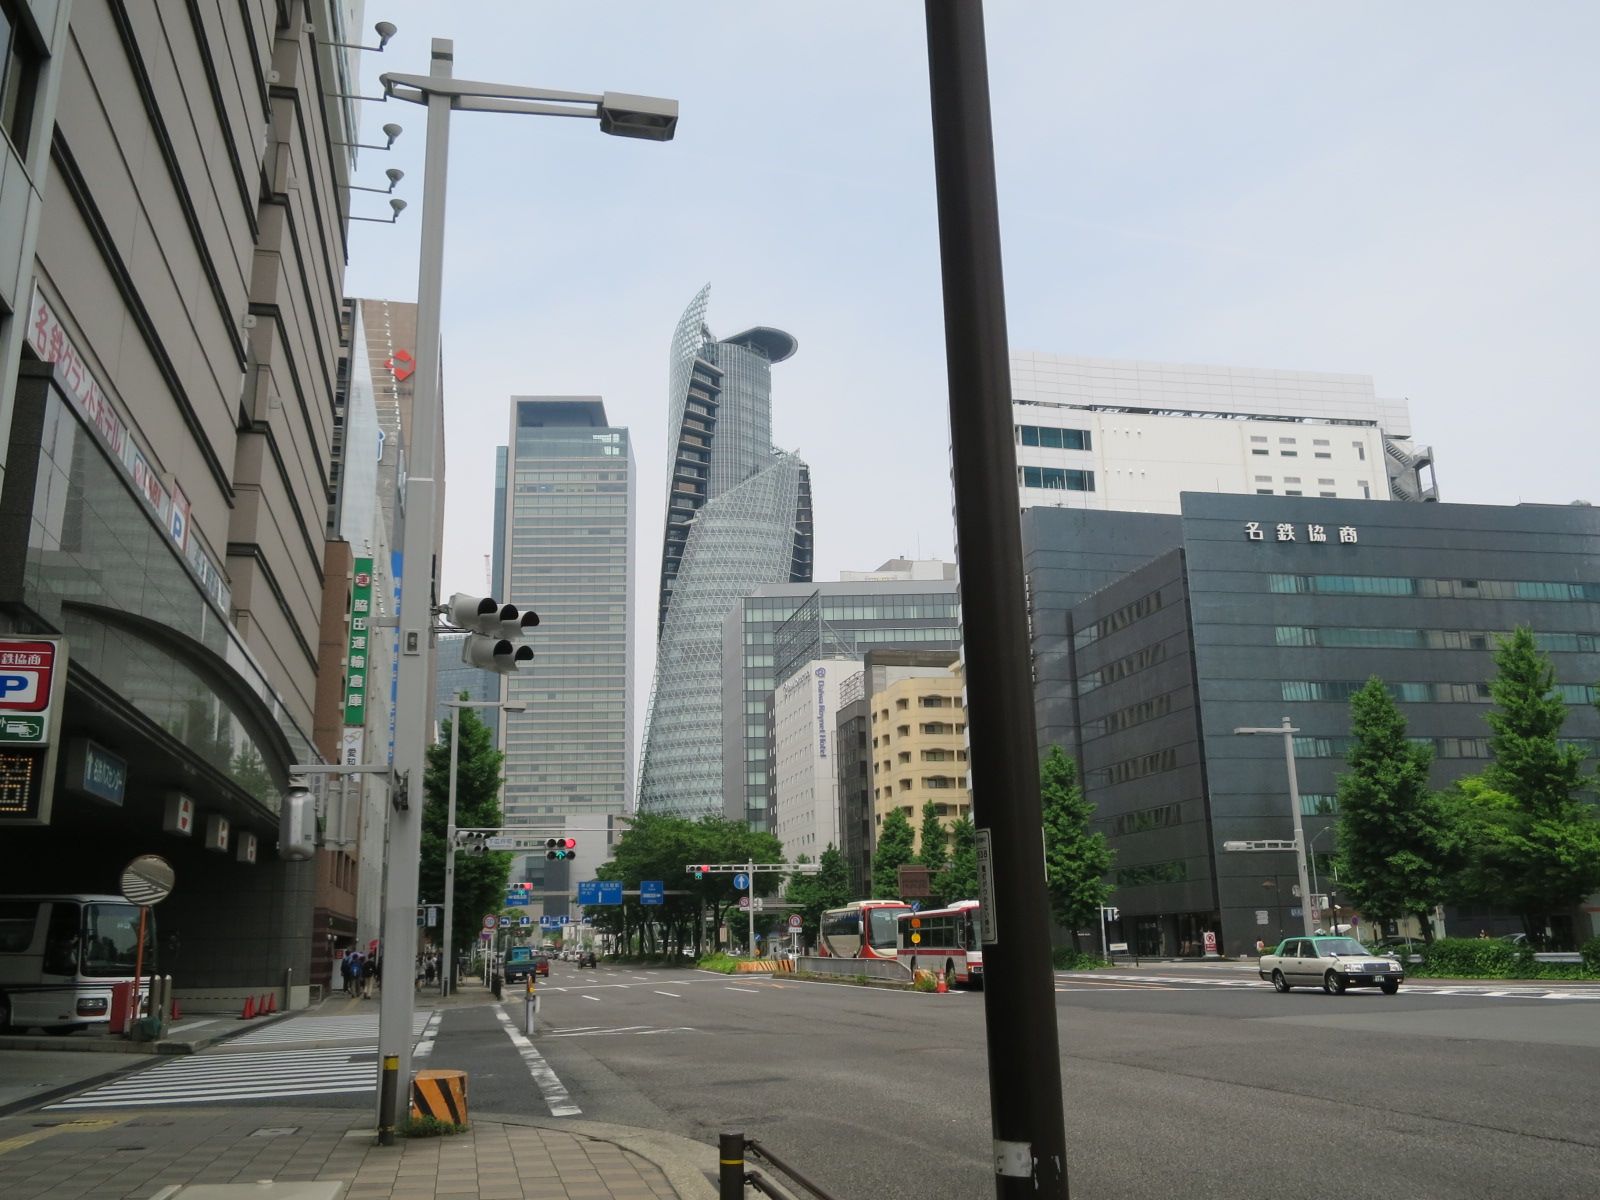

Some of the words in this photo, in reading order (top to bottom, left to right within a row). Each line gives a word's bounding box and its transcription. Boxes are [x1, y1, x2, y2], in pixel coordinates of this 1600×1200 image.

[171, 511, 182, 540] P
[1245, 521, 1358, 543] 名鉄協商
[1, 653, 41, 665] 鉄協商
[0, 675, 28, 698] P
[817, 680, 825, 704] Daiwa
[817, 704, 825, 734] Roynet
[819, 734, 827, 758] Hotel
